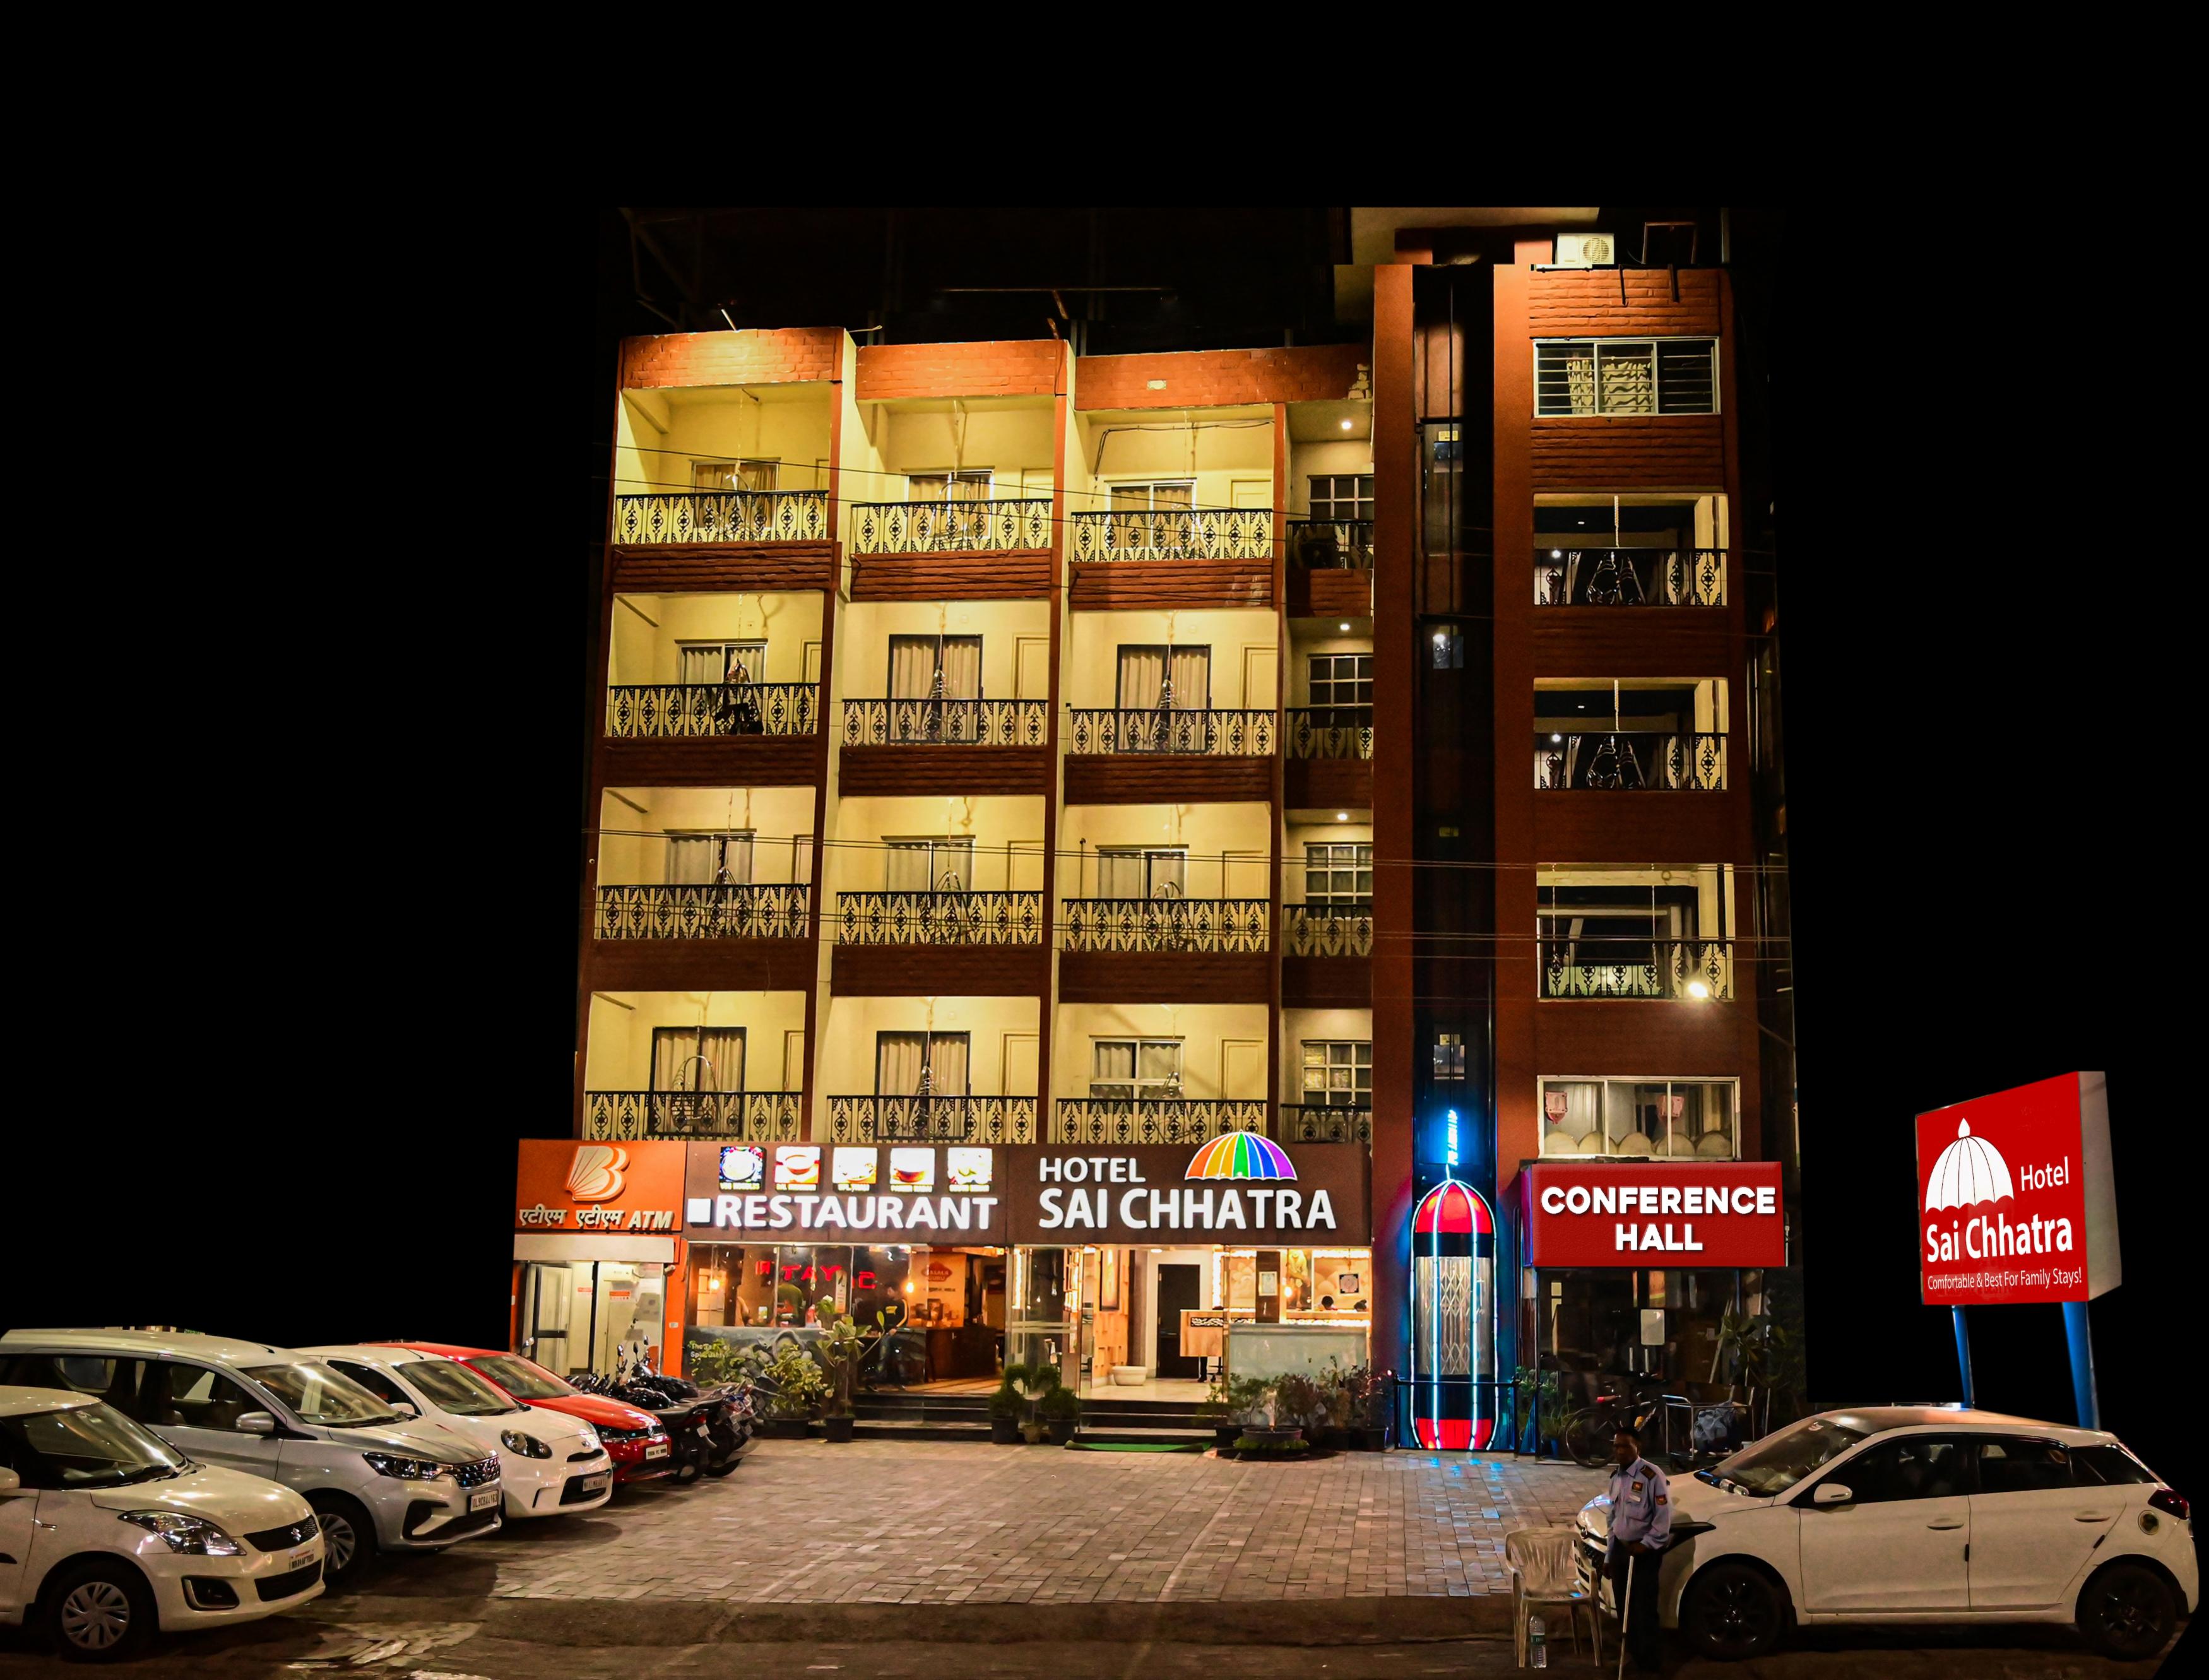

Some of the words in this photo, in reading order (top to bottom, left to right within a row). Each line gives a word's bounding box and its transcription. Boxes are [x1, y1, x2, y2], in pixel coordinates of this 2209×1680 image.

[1039, 1157, 1146, 1183] HOTEL
[2020, 1156, 2070, 1192] Hotel
[716, 1195, 998, 1230] RESTAURANT
[1038, 1188, 1108, 1229] SAI
[1120, 1188, 1337, 1229] CHHATRA
[1541, 1186, 1775, 1215] CONFERENCE
[519, 1204, 567, 1226] एटीएम
[576, 1204, 624, 1227] एटीएम
[627, 1210, 674, 1229] ATM
[1616, 1223, 1703, 1251] HALL
[1926, 1220, 1960, 1262] Sai
[1965, 1213, 2073, 1258] Chhatra
[1928, 1274, 1975, 1290] Comfortable
[1977, 1273, 1983, 1287] &
[1984, 1272, 2003, 1287] Best
[2004, 1271, 2018, 1286] For
[2020, 1268, 2051, 1289] Family
[2052, 1267, 2082, 1289] Stays!
